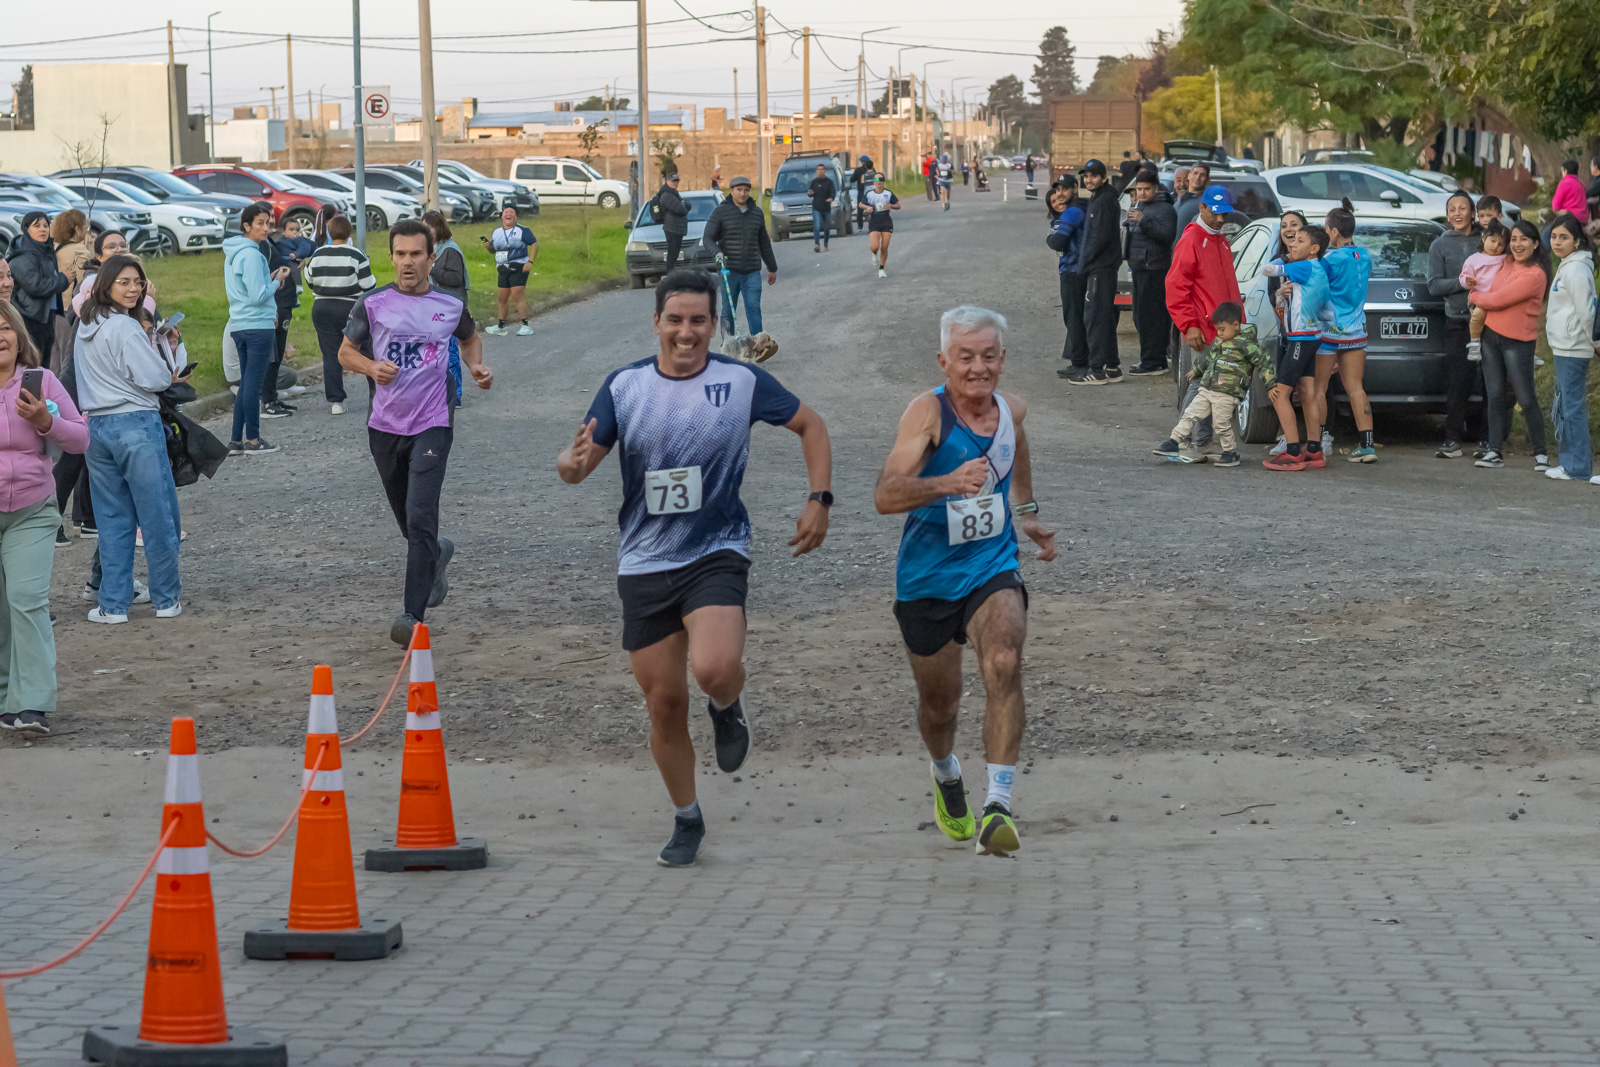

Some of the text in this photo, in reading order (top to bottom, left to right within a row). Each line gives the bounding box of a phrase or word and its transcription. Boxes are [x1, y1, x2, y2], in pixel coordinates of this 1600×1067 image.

[371, 99, 383, 113] E
[432, 313, 446, 322] AC
[1382, 323, 1426, 335] PKT 477
[387, 342, 423, 361] 8K
[652, 483, 689, 512] 73
[962, 511, 993, 540] 83
